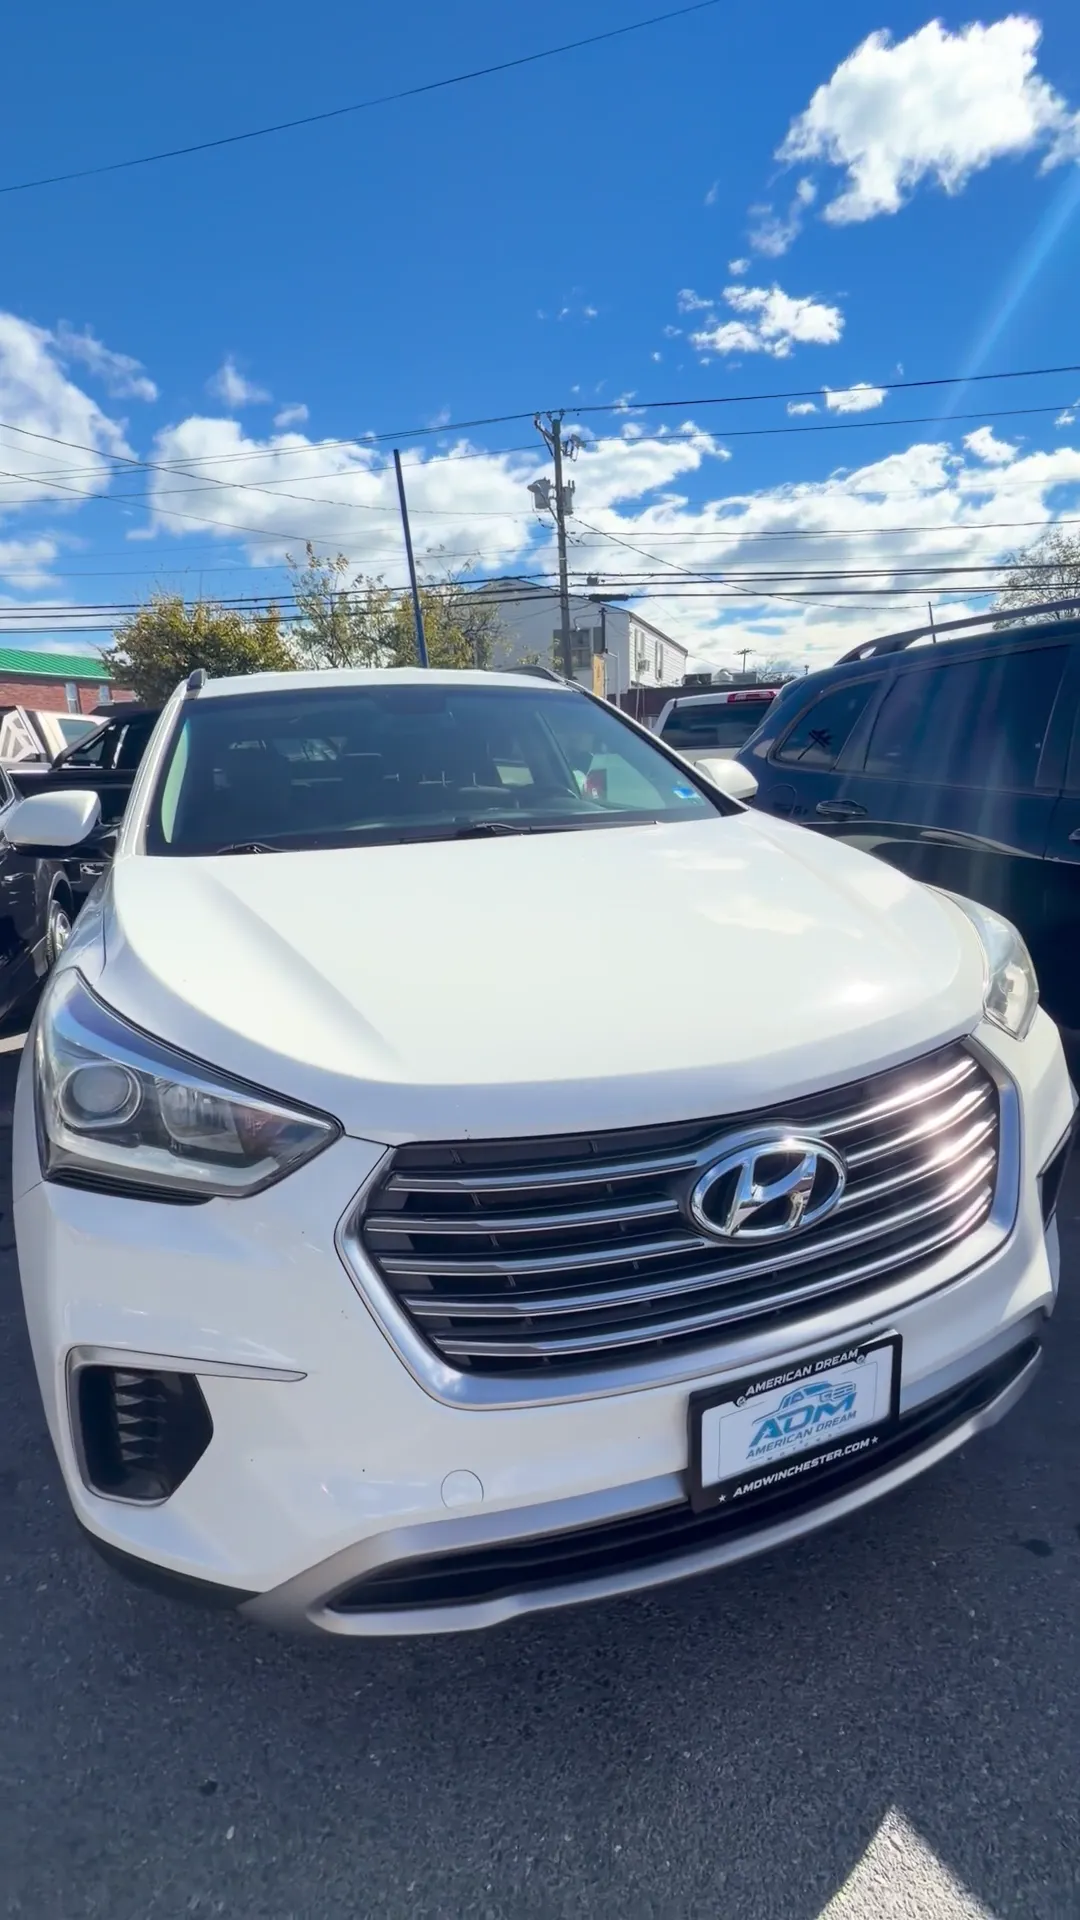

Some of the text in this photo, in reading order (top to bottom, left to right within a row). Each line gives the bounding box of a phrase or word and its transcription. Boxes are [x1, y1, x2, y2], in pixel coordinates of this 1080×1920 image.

[746, 1348, 859, 1396] AMERICAN DREAM
[746, 1427, 813, 1459] AMERICAN
[815, 1410, 857, 1432] DREAM
[749, 1391, 857, 1447] ADM
[733, 1438, 870, 1497] AMDWINCHESTER.COM
